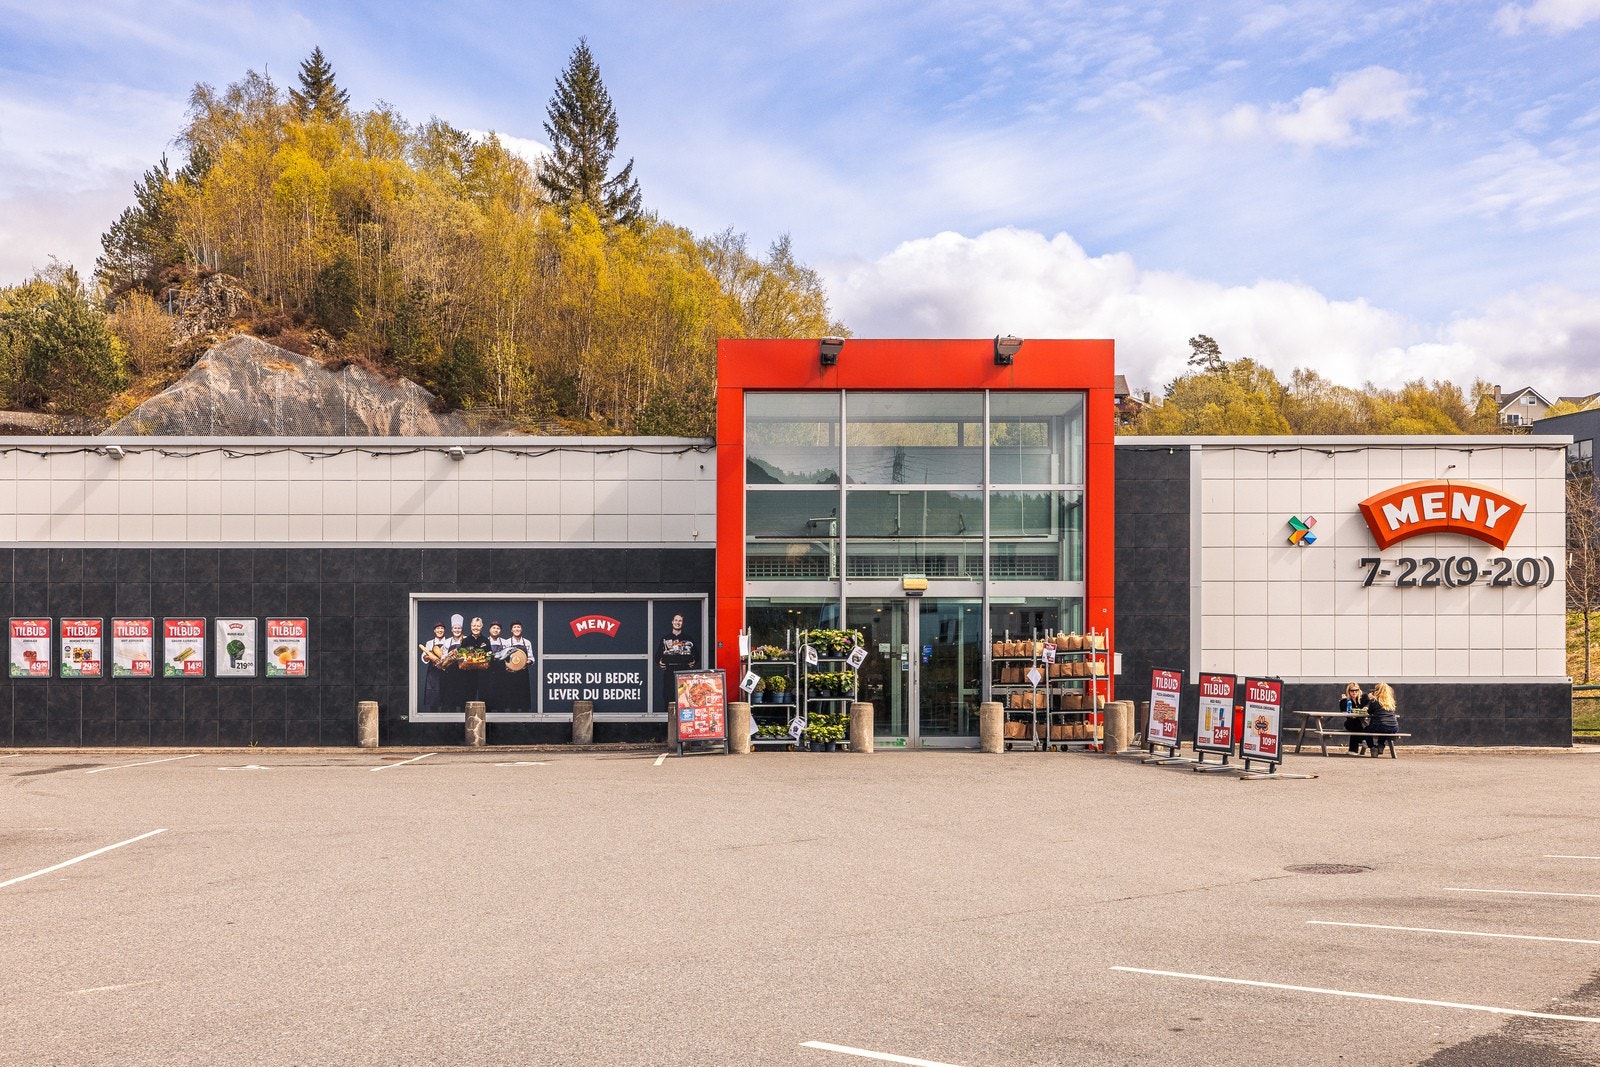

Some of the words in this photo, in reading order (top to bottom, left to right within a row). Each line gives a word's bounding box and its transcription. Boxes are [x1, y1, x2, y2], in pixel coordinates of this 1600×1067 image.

[1381, 491, 1511, 531] MENY
[15, 626, 47, 636] TILBUD
[66, 626, 98, 636] TILBUD
[117, 626, 149, 636] TILBUD
[168, 626, 201, 636] TILBUD
[271, 626, 303, 636] TILBUD
[575, 619, 615, 632] MENY
[546, 672, 582, 684] SPISER
[585, 672, 602, 684] DU
[605, 672, 643, 686] BEDRE,
[1155, 676, 1178, 690] TILBUD
[548, 688, 580, 700] LEVER
[583, 688, 599, 700] DU
[603, 688, 641, 700] BEDRE!
[1203, 683, 1231, 696] TILBUD
[1249, 687, 1278, 702] TILBUD
